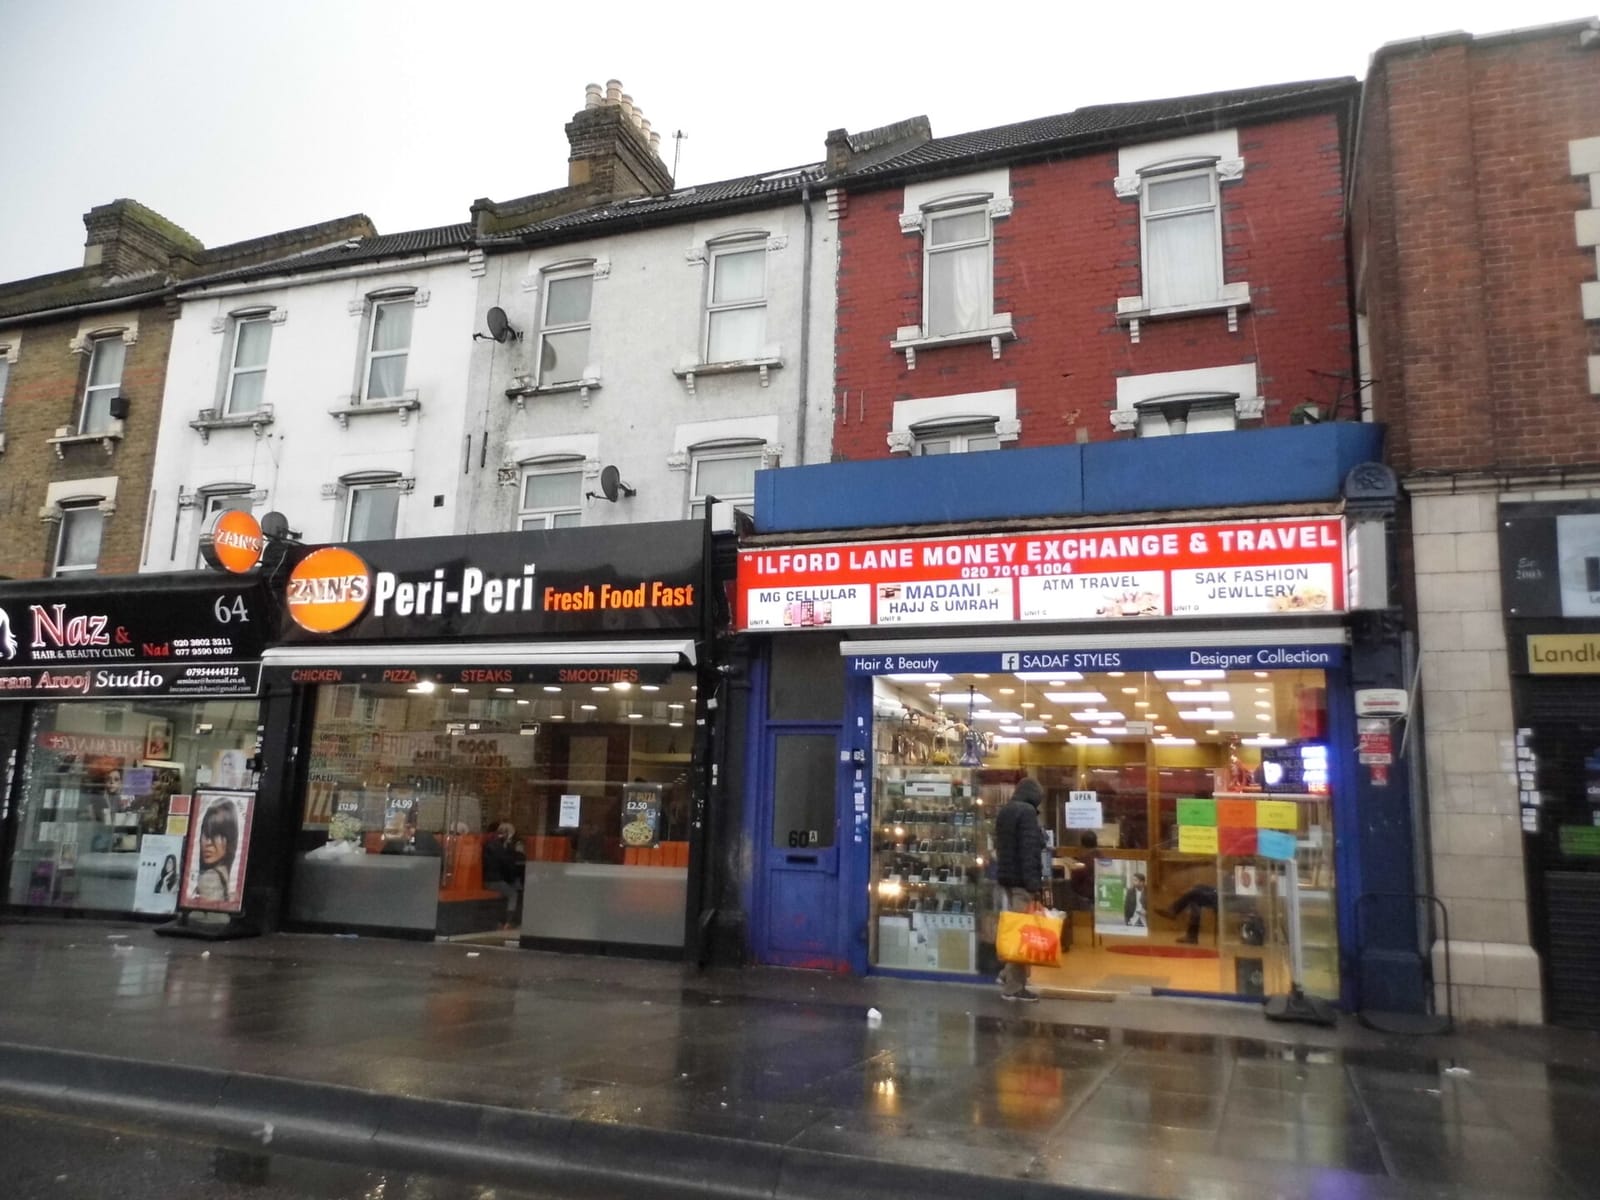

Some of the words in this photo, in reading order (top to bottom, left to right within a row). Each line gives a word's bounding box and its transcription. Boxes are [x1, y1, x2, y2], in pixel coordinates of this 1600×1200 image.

[757, 552, 840, 574] ILFORD
[850, 548, 913, 569] LANE
[923, 543, 1016, 567] MONEY
[1026, 533, 1179, 561] EXCHANGE
[1189, 532, 1209, 553] &
[1218, 525, 1337, 551] TRAVEL
[961, 566, 989, 578] 020
[993, 564, 1029, 577] 7018
[1035, 562, 1072, 575] 1004
[1195, 571, 1227, 584] SAK
[1234, 568, 1309, 583] FASHION
[289, 575, 370, 604] ZAIN'S
[374, 563, 536, 616] Peri-Peri
[1043, 578, 1074, 591] ATM
[1080, 576, 1140, 589] TRAVEL
[544, 585, 594, 612] Fresh
[600, 582, 646, 609] Food
[652, 581, 695, 607] Fast
[759, 591, 781, 603] MG
[786, 588, 857, 602] CELLULAR
[906, 583, 981, 600] MADANI
[1208, 584, 1296, 599] JEWLLERY
[213, 593, 250, 624] 64
[889, 601, 925, 614] HAJJ
[930, 600, 940, 612] &
[945, 599, 999, 612] UMRAH
[29, 603, 111, 648] Naz
[115, 625, 132, 644] &
[32, 650, 57, 660] HAIR
[57, 650, 65, 659] &
[66, 649, 100, 659] BEAUTY
[101, 647, 136, 658] CLINIC
[1023, 654, 1070, 668] SADAF
[1074, 653, 1121, 667] STYLES
[1190, 651, 1251, 668] Designer
[1256, 649, 1329, 664] Collection
[855, 657, 882, 671] Hair
[884, 657, 895, 669] &
[898, 657, 939, 672] Beauty
[35, 670, 92, 694] Arooj
[95, 669, 164, 688] Studio
[291, 669, 343, 682] CHICKEN
[382, 669, 418, 682] PIZZA
[460, 669, 513, 683] STEAKS
[559, 668, 640, 682] SMOOTHIES
[391, 799, 413, 809] £4.99
[1073, 792, 1092, 801] OPEN
[626, 801, 648, 811] £2.50
